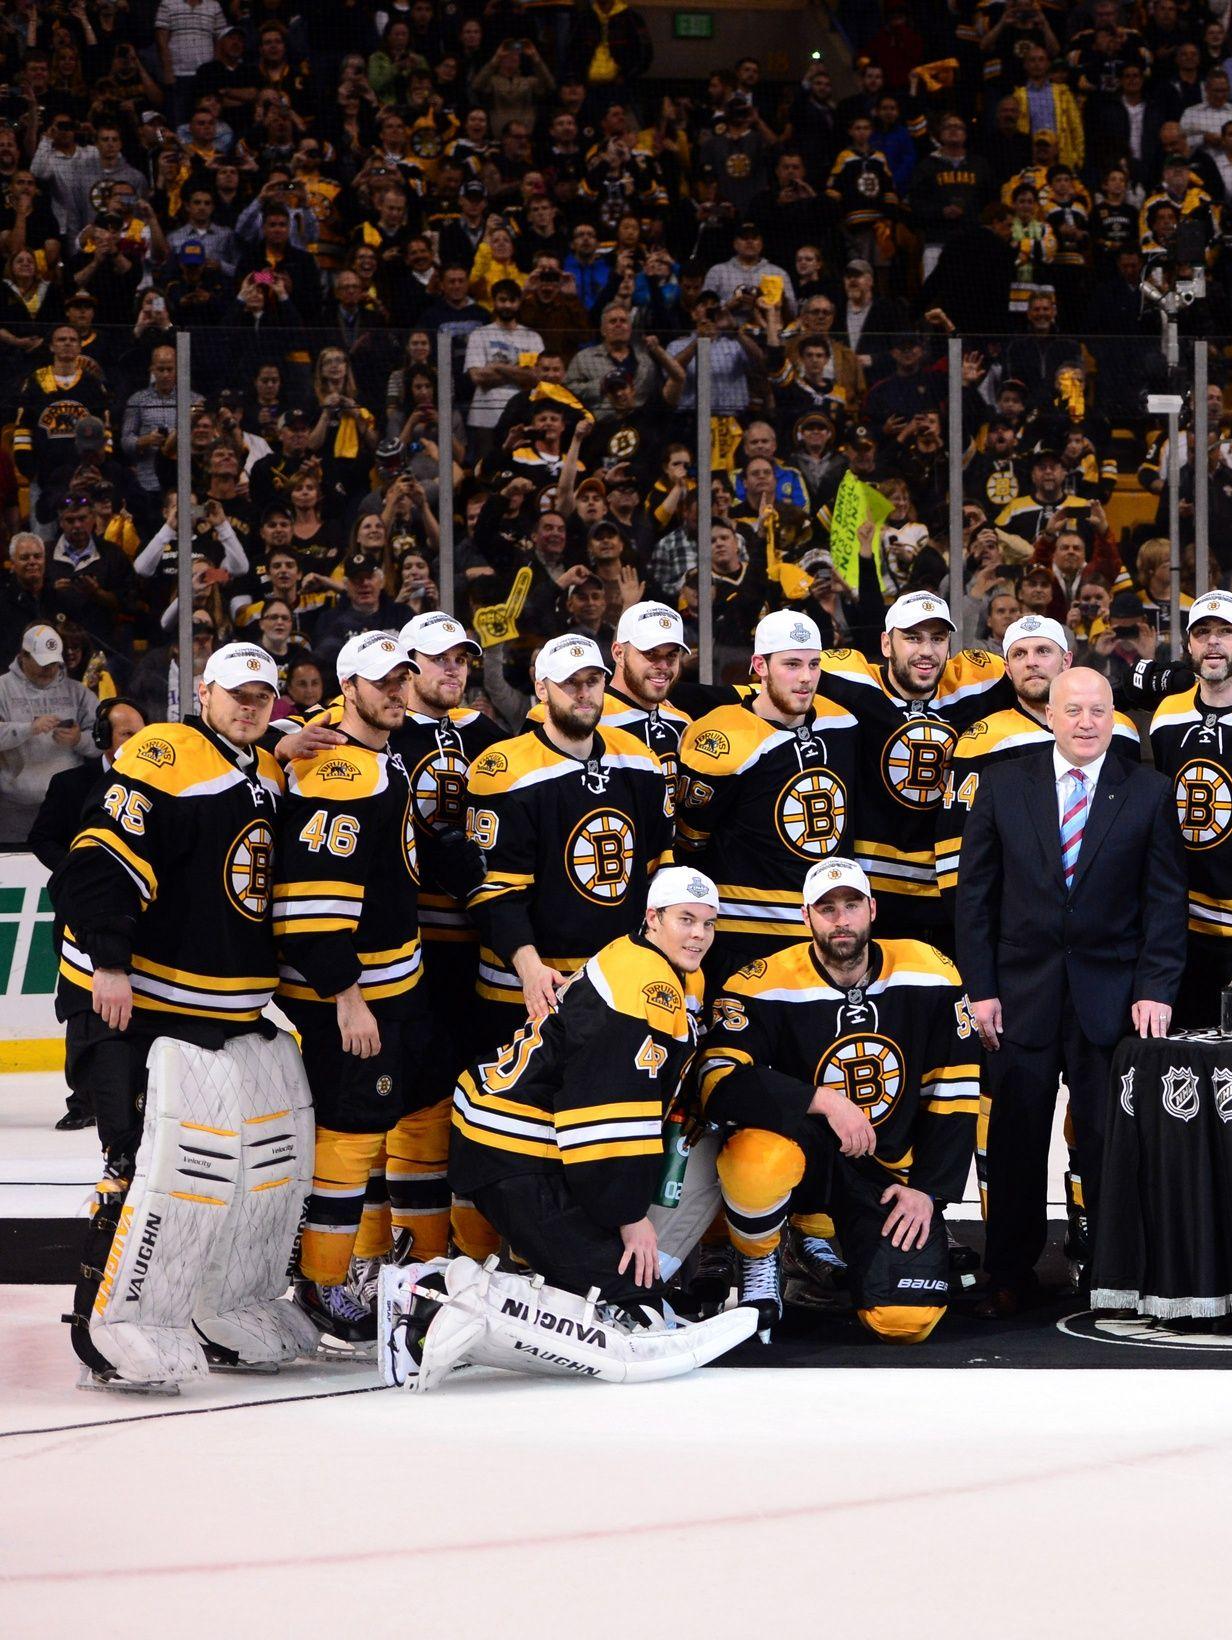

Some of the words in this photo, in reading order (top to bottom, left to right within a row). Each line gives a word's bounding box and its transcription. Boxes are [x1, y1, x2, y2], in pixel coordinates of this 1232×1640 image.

[698, 732, 726, 750] BRUINS
[320, 760, 356, 773] BRUINS
[906, 739, 946, 792] B
[103, 784, 153, 836] 35
[436, 769, 468, 828] B
[800, 788, 833, 841] B
[943, 771, 979, 811] 44
[1184, 779, 1215, 831] B
[300, 810, 360, 857] 46
[590, 830, 627, 884] B
[247, 841, 271, 899] B
[648, 983, 679, 1003] BRUINS
[841, 1055, 884, 1104] B
[1175, 1082, 1194, 1105] NHL
[183, 1156, 212, 1169] Velocity
[271, 1144, 294, 1156] Velocity
[126, 1212, 162, 1302] VAUGHN
[514, 1341, 602, 1377] VAUGHN
